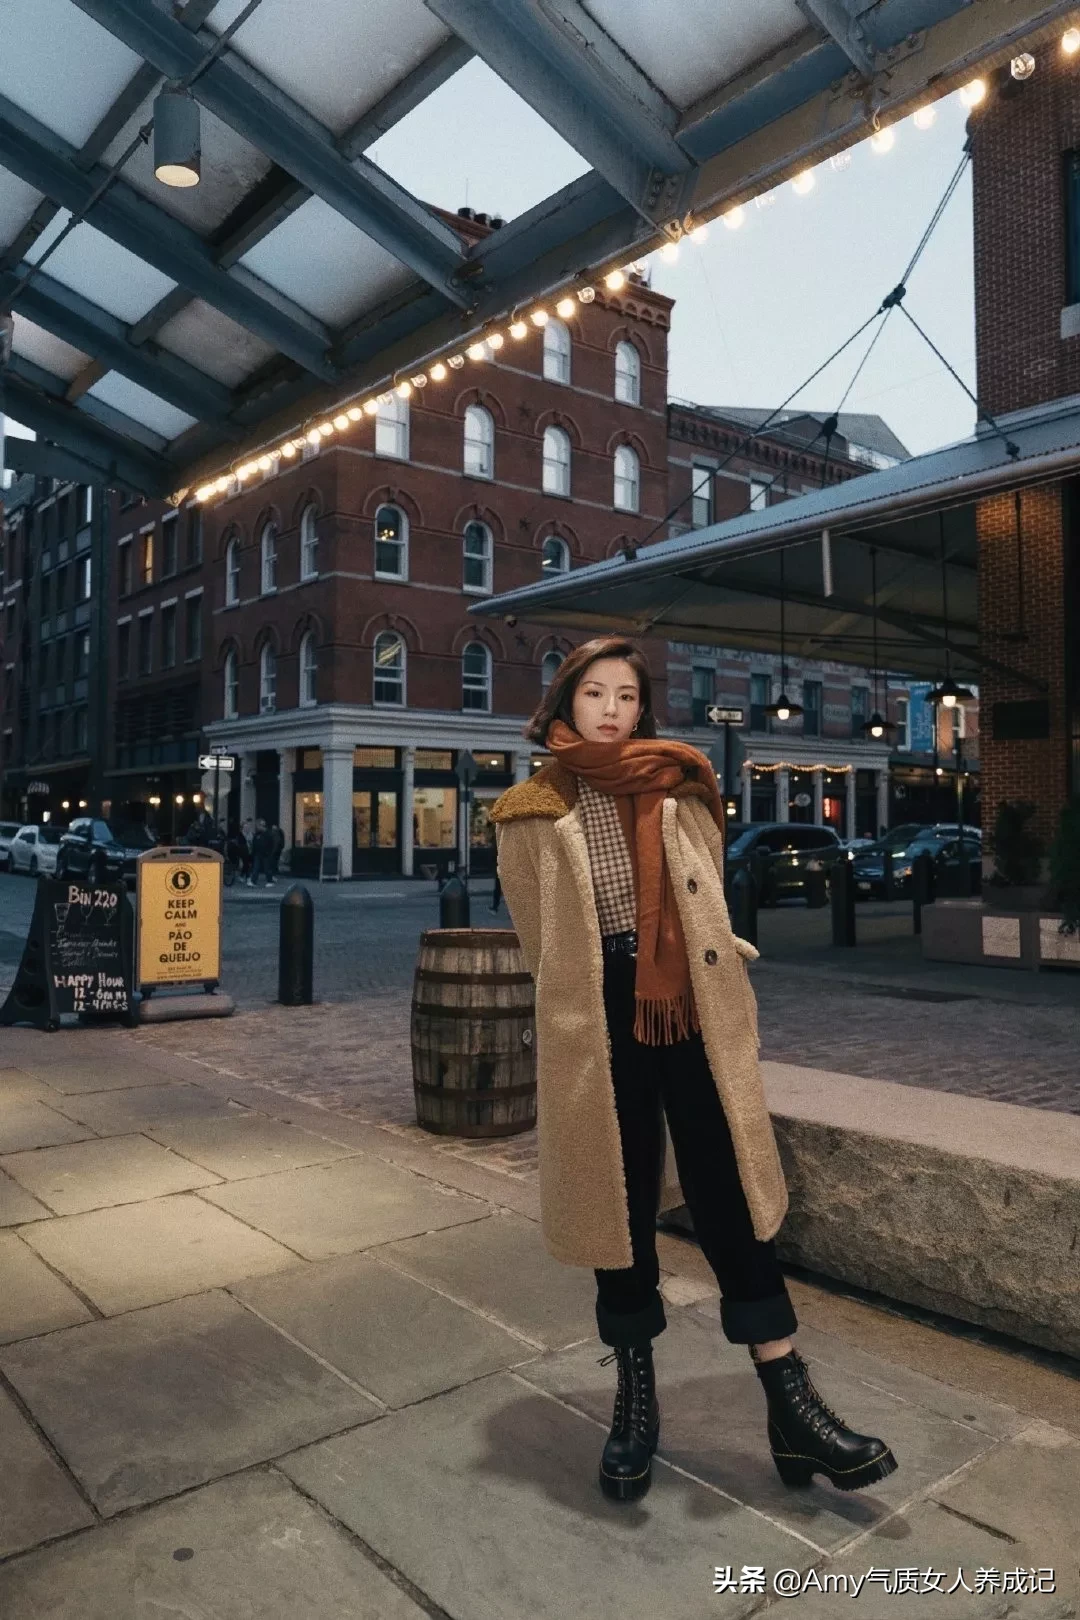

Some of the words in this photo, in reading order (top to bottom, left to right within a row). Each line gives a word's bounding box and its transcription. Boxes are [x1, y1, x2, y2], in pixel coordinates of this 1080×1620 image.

[94, 889, 118, 908] 220
[168, 899, 194, 909] KEEP
[164, 909, 197, 920] CALM
[173, 942, 187, 951] DE
[159, 952, 201, 963] QUEIJO
[54, 974, 94, 988] HAPPY
